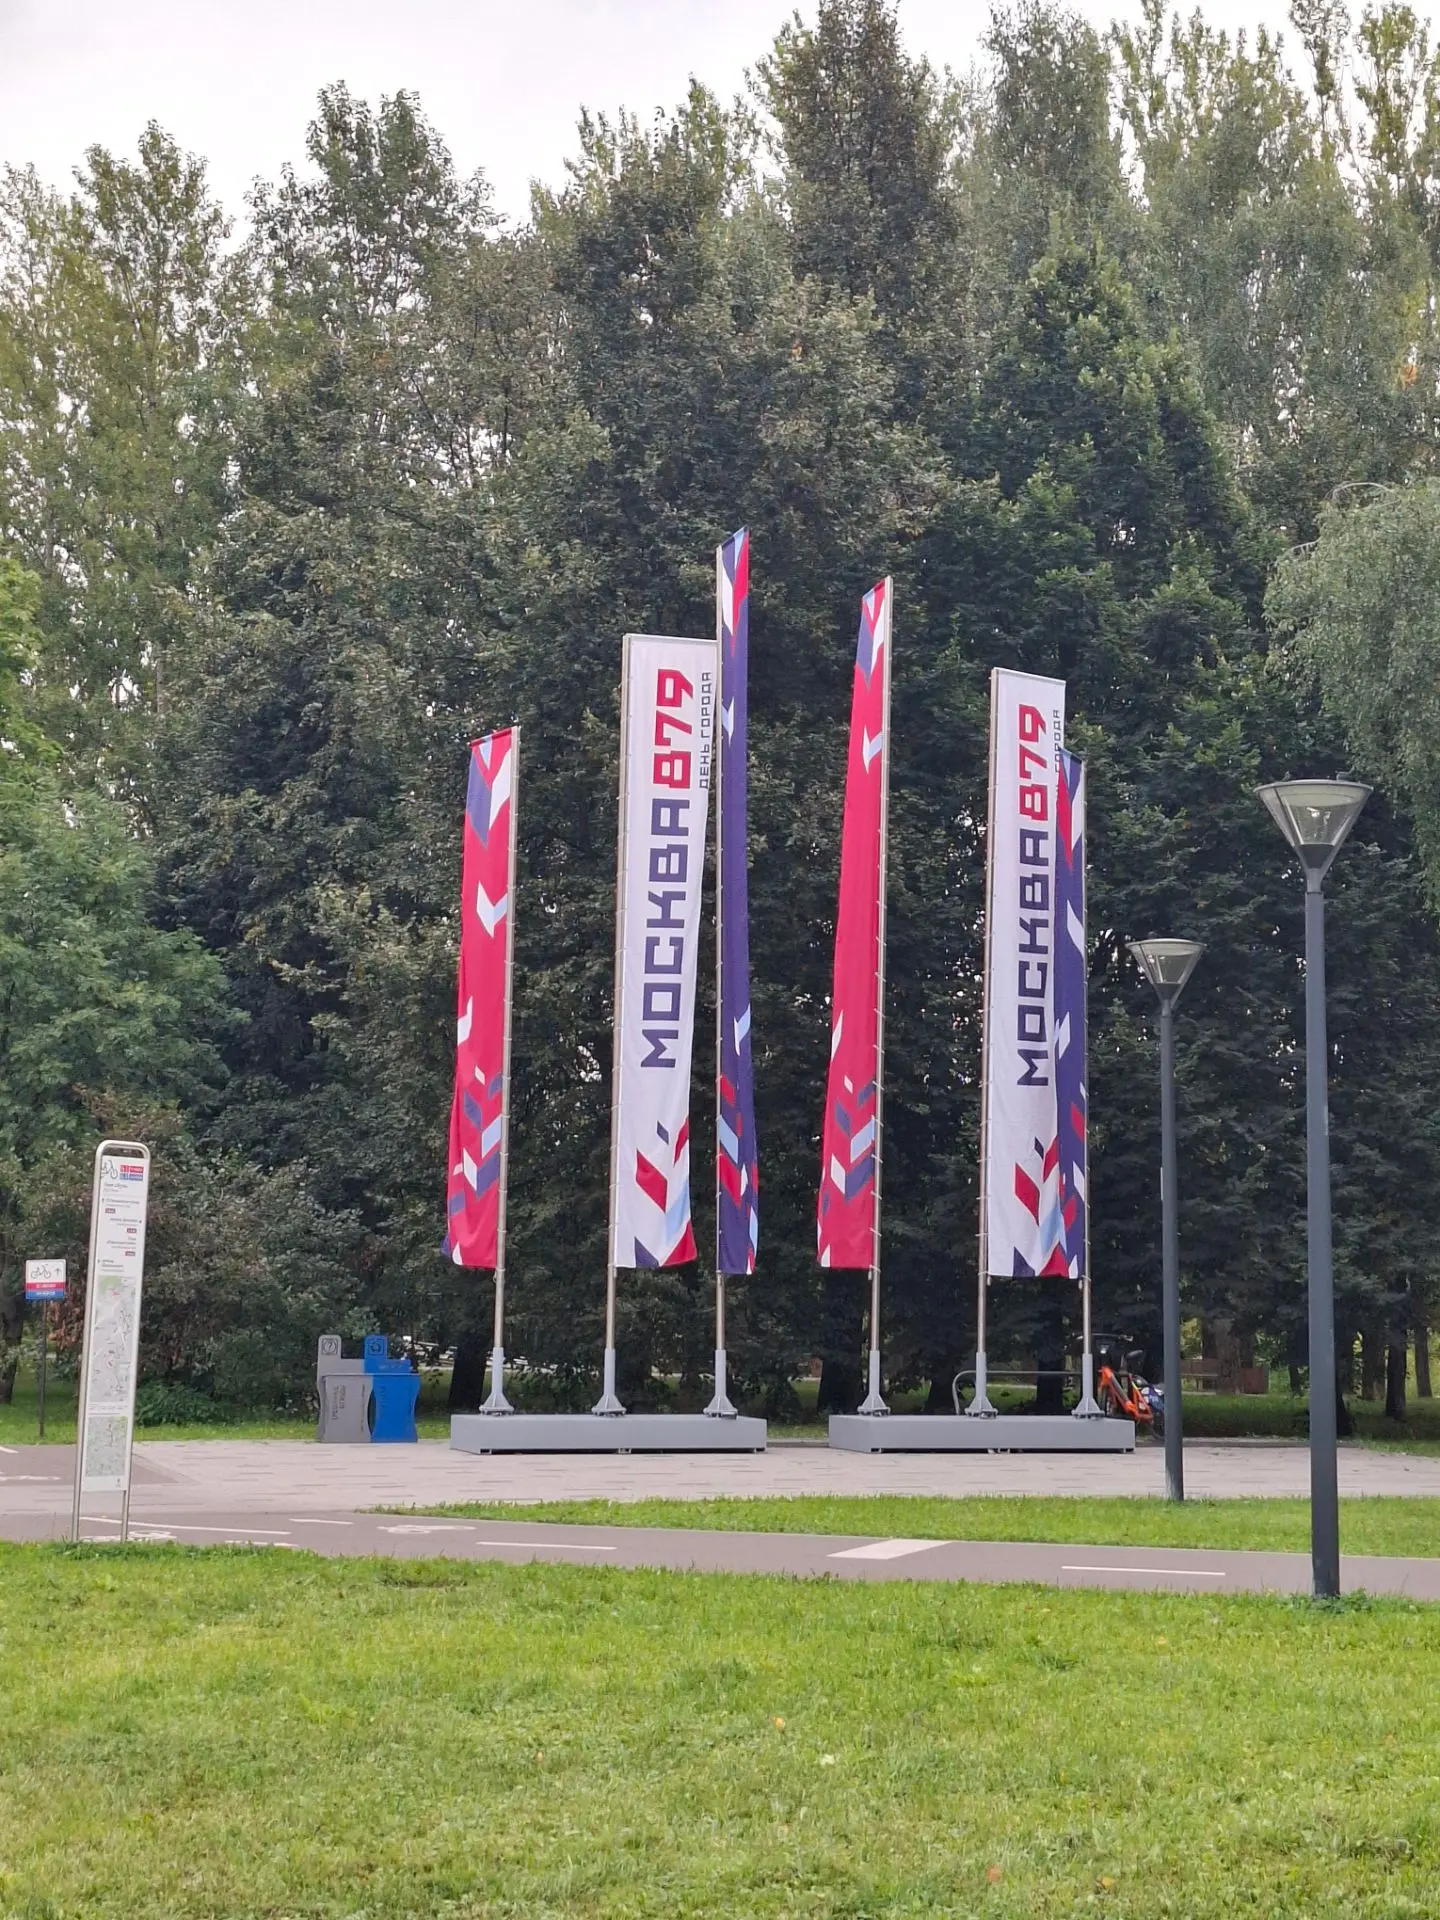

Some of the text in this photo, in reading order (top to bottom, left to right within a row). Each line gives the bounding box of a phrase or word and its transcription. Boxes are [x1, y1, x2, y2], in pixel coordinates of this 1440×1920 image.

[640, 668, 694, 1068] МОСКВА 879
[699, 672, 712, 790] ДЕНЬ ГОРОДА
[1017, 704, 1049, 1087] МОСКВА 879
